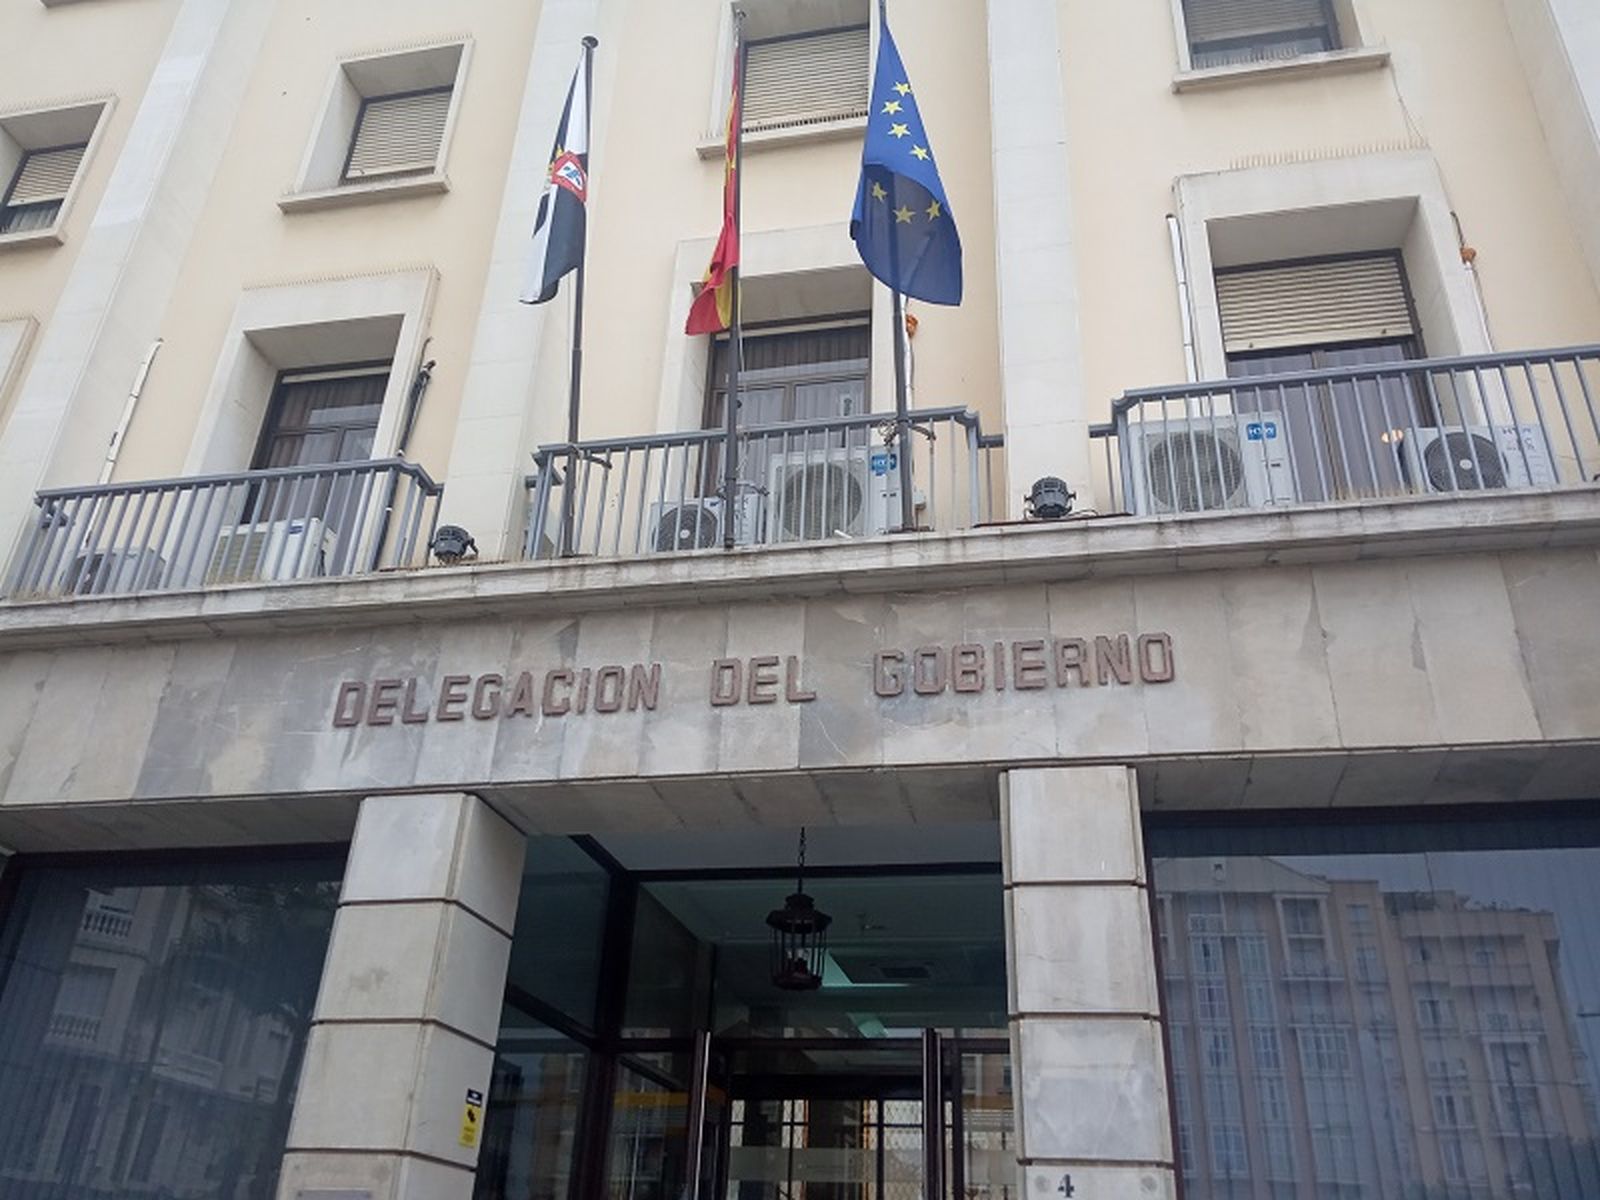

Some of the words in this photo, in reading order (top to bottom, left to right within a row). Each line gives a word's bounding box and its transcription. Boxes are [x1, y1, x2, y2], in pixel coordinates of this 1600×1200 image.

[332, 663, 661, 728] DELEGACION
[709, 655, 817, 706] DEL
[873, 631, 1175, 698] GOBIERNO
[1057, 1173, 1075, 1199] 4
